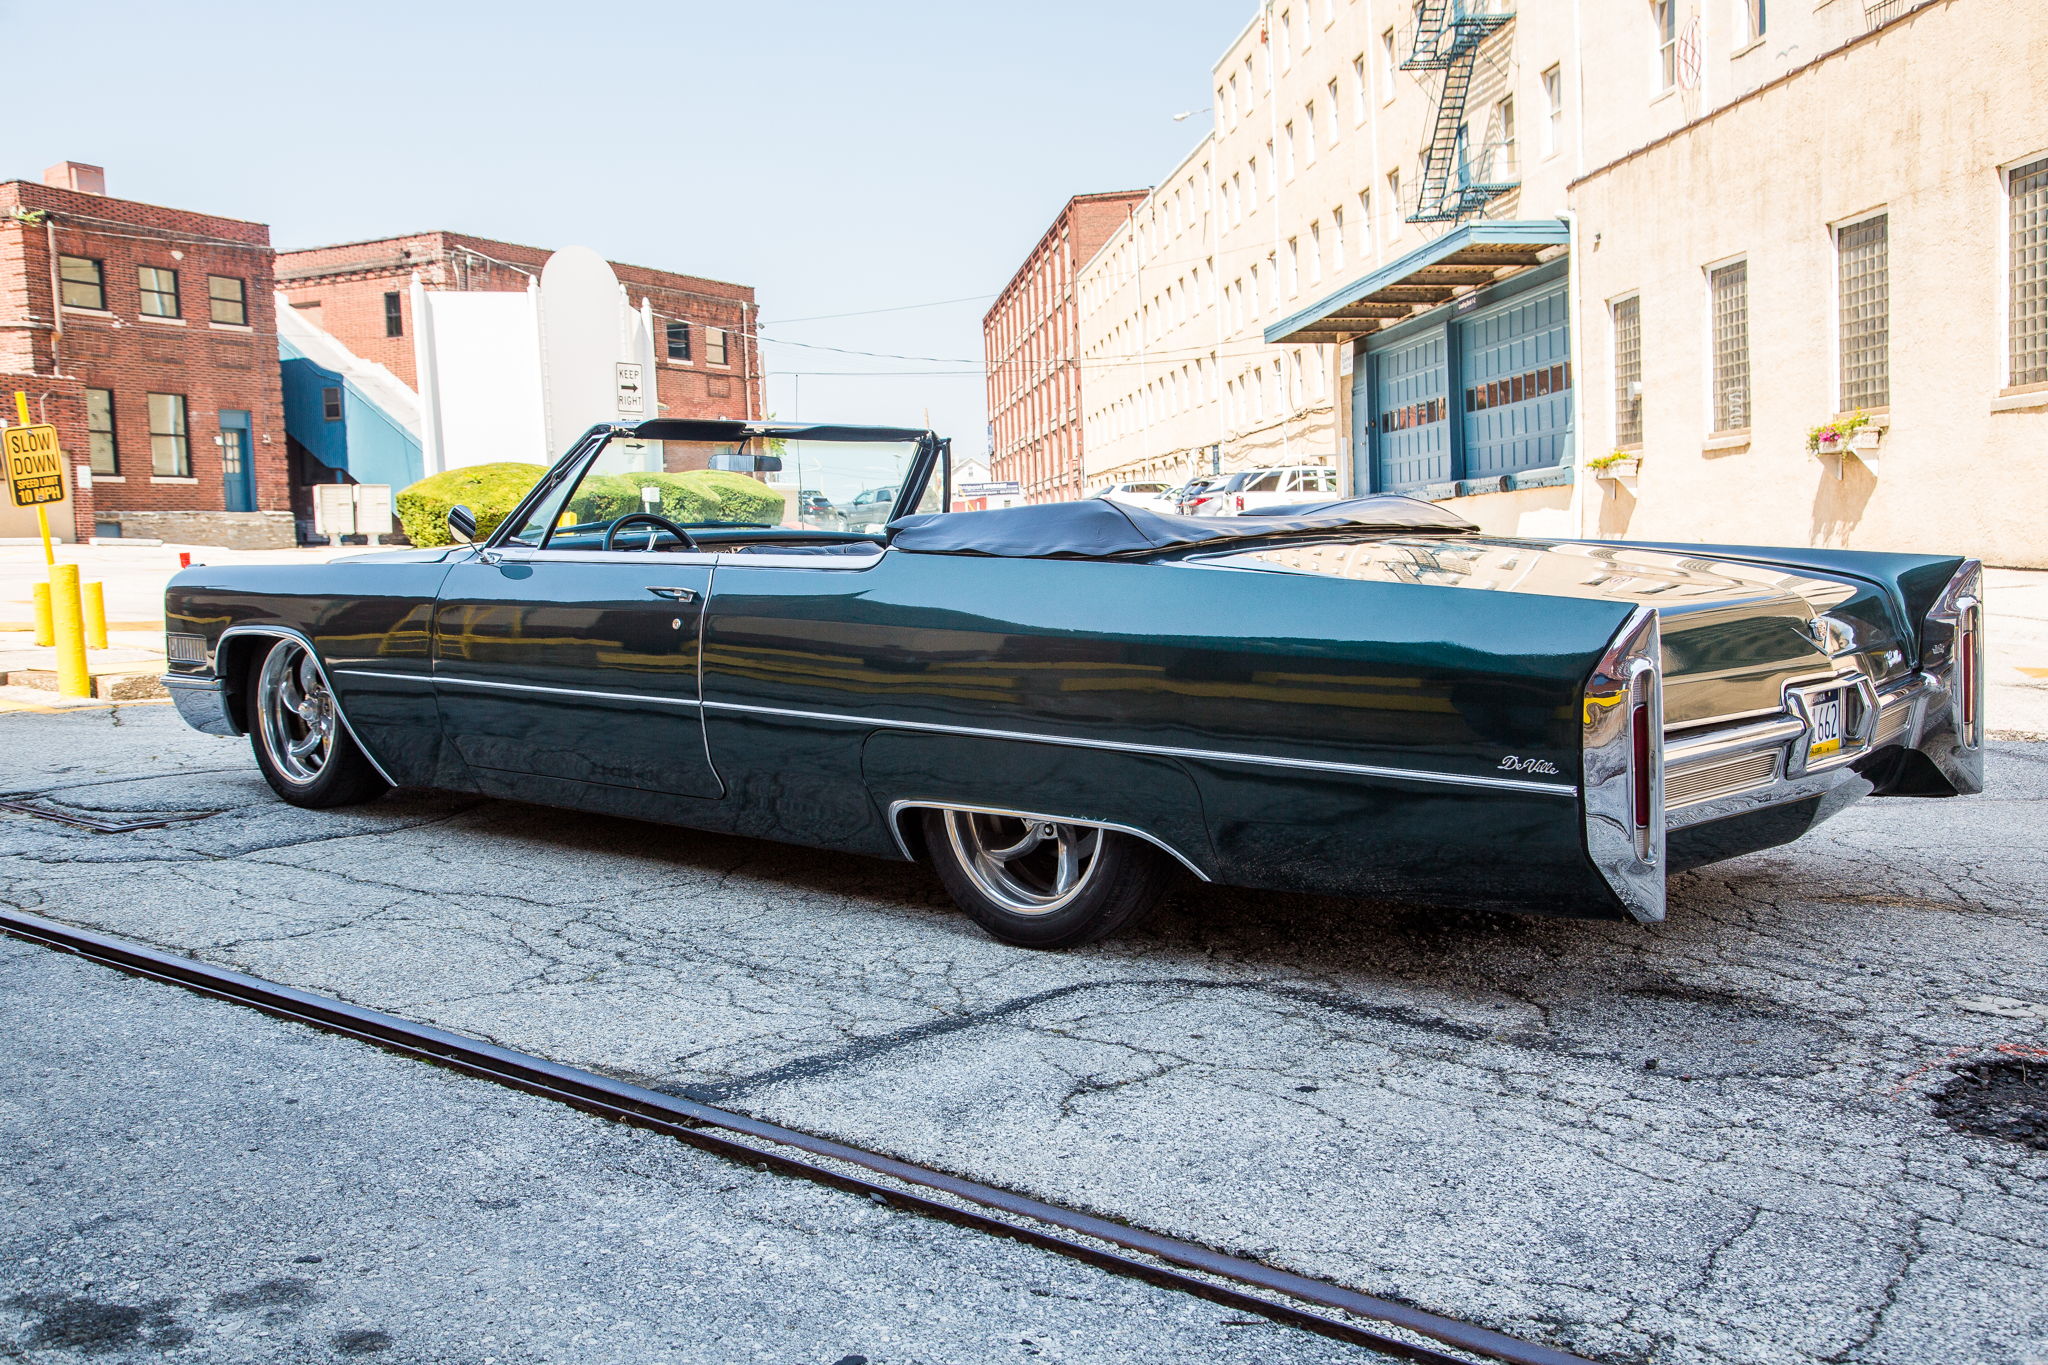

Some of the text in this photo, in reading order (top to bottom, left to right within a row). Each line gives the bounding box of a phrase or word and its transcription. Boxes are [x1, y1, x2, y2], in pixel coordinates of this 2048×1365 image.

[619, 369, 639, 379] KEEP
[618, 396, 641, 405] RIGHT
[11, 432, 51, 454] SLOW
[14, 454, 57, 475] DOWN
[16, 476, 59, 489] SPEED LIMIT
[18, 485, 62, 503] 10 MPH
[1497, 755, 1559, 775] DeVille
